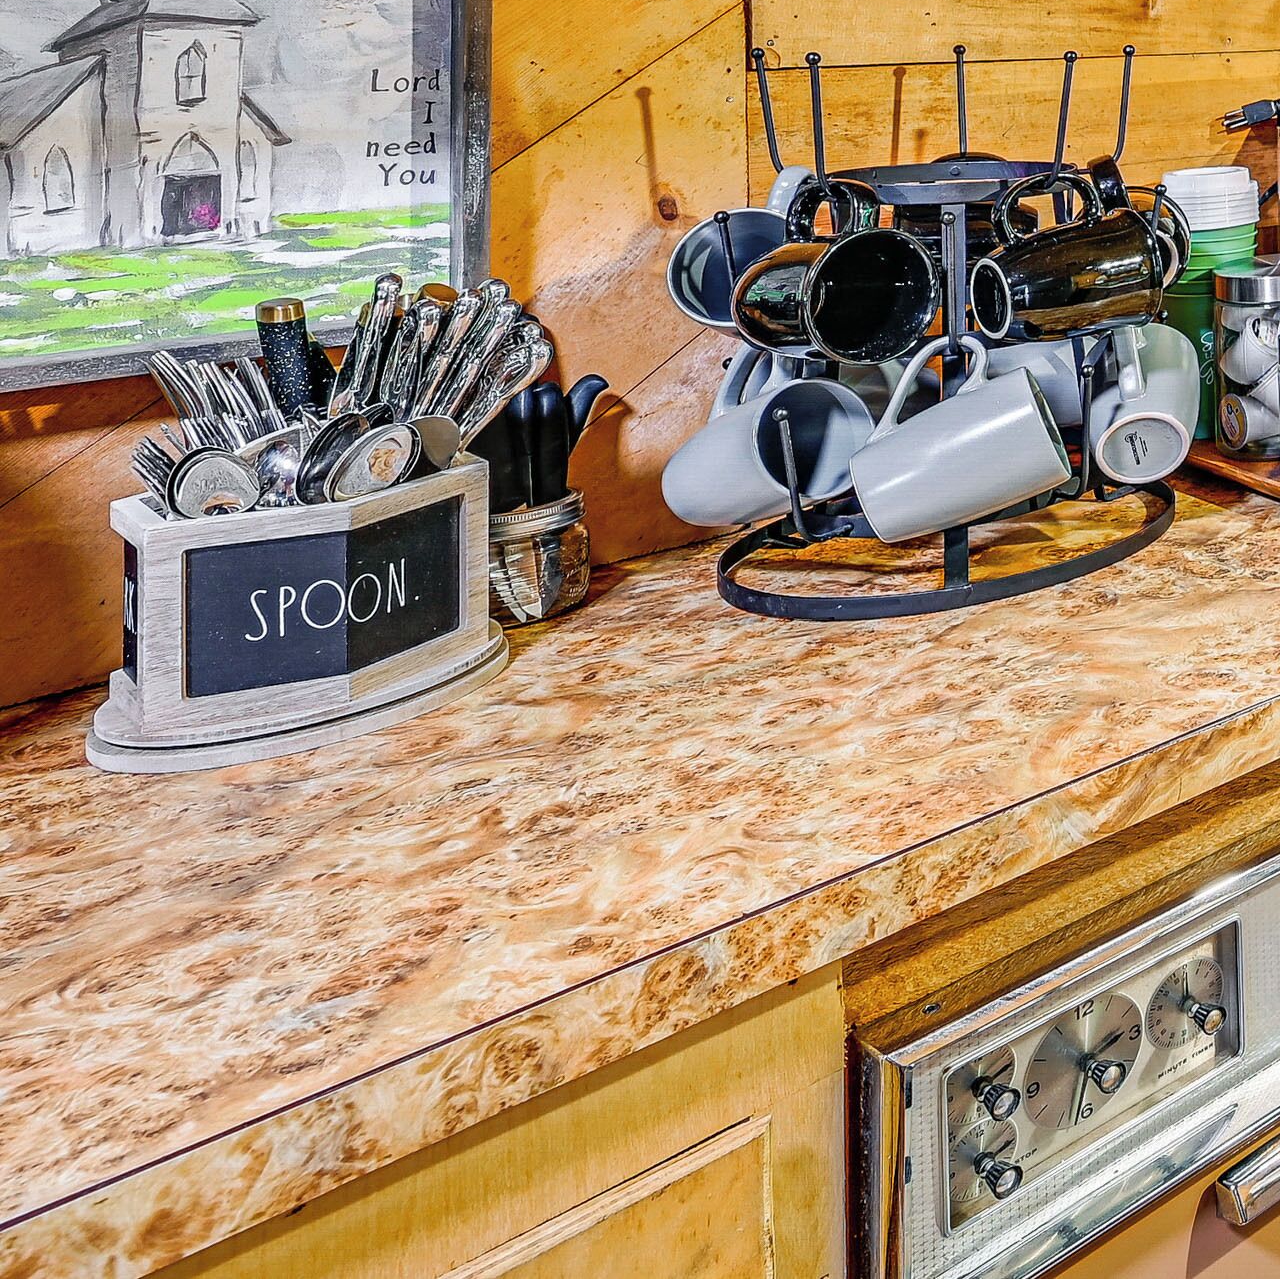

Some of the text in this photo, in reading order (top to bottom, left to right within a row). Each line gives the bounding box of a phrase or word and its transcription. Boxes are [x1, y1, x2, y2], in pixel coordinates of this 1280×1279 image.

[371, 69, 440, 92] Lord
[423, 101, 436, 124] I
[366, 132, 437, 157] need
[378, 163, 436, 187] You
[1073, 999, 1094, 1021] 12
[1129, 1027, 1141, 1041] 3
[1158, 1042, 1214, 1079] MINUTE TIMER
[1026, 1082, 1041, 1099] 9
[1081, 1103, 1093, 1119] 6
[1014, 1147, 1038, 1164] STOP
